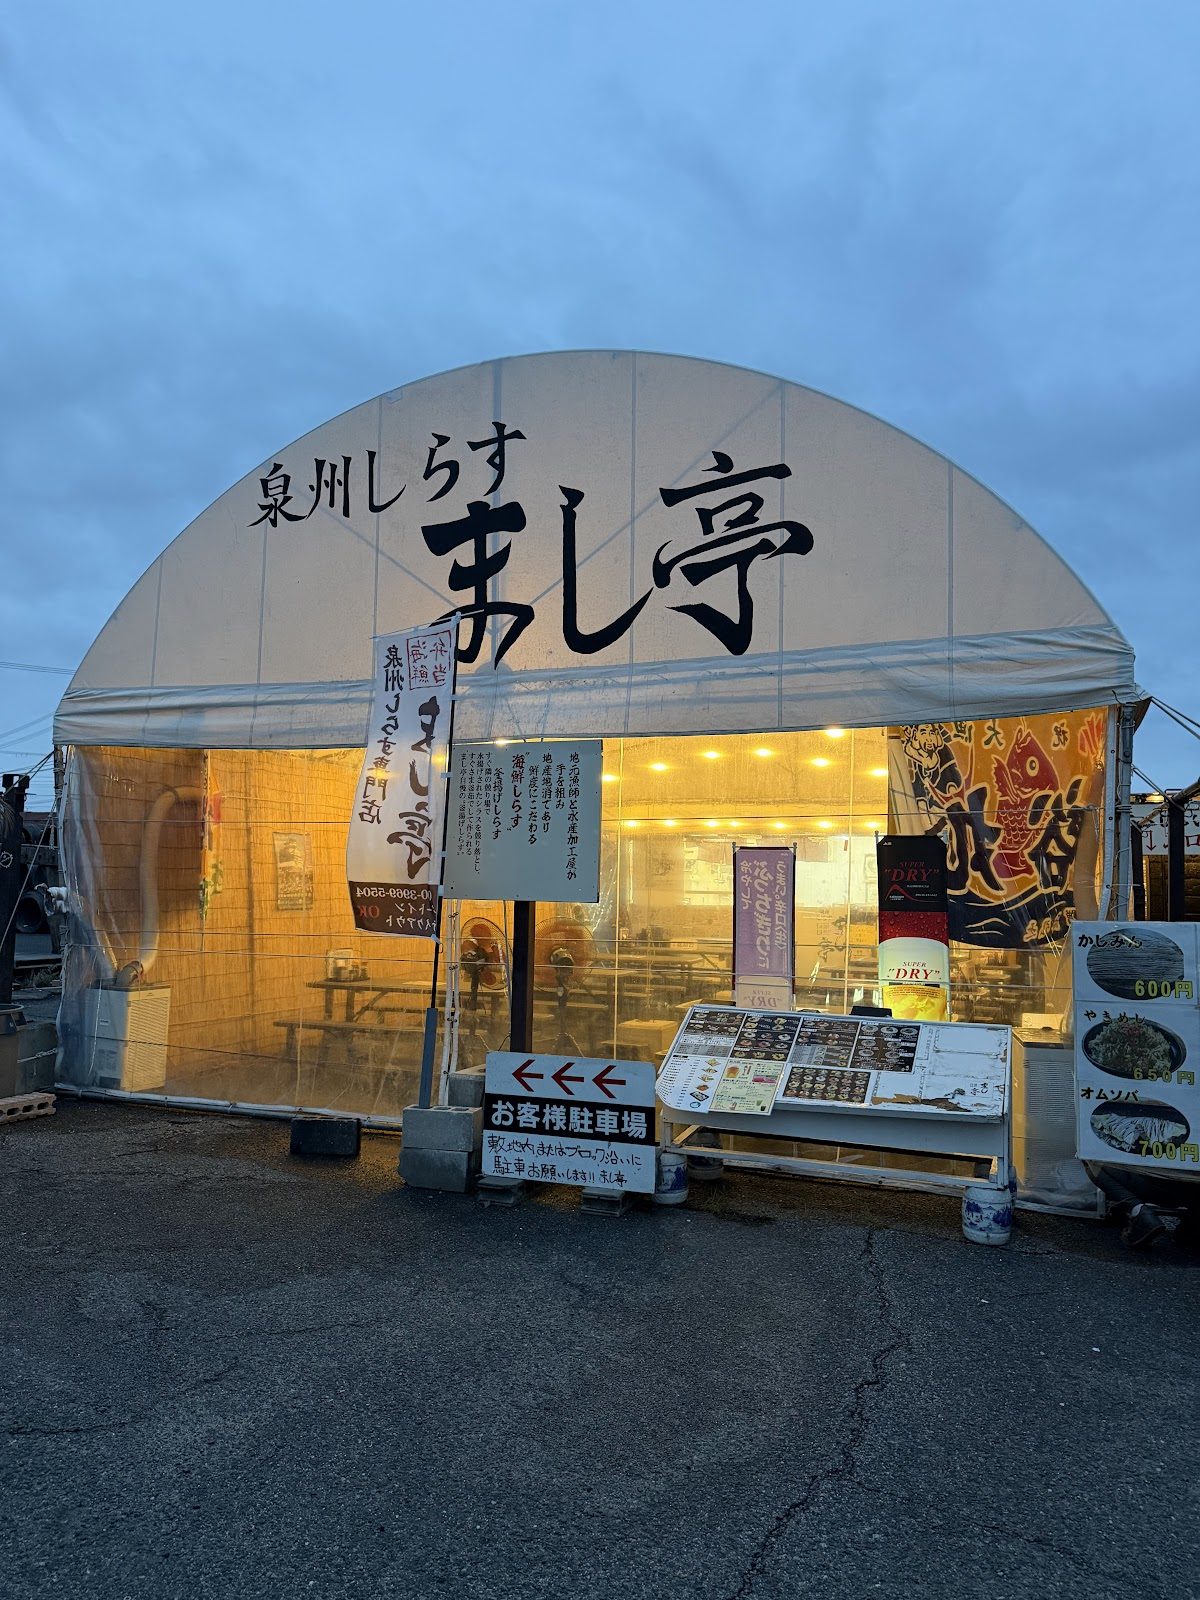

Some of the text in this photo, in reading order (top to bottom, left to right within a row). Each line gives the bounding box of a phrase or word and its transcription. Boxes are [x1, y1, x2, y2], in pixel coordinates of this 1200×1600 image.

[247, 421, 527, 528] 泉州しらす
[421, 450, 814, 671] まし亭
[554, 763, 566, 810] 手を組み
[492, 767, 504, 841] 釜揚げしらす
[528, 764, 540, 845] 鮮度にこだわる
[565, 751, 580, 880] 地元漁師と水産加工屋が
[899, 860, 925, 868] SUPER
[1078, 933, 1143, 950] かしみん
[1134, 980, 1195, 999] 600円
[1083, 1009, 1146, 1025] やきめし
[1133, 1067, 1195, 1086] 650円
[1080, 1086, 1139, 1102] オムソバ
[491, 1100, 648, 1139] お客様駐車場
[1138, 1140, 1199, 1163] 700円
